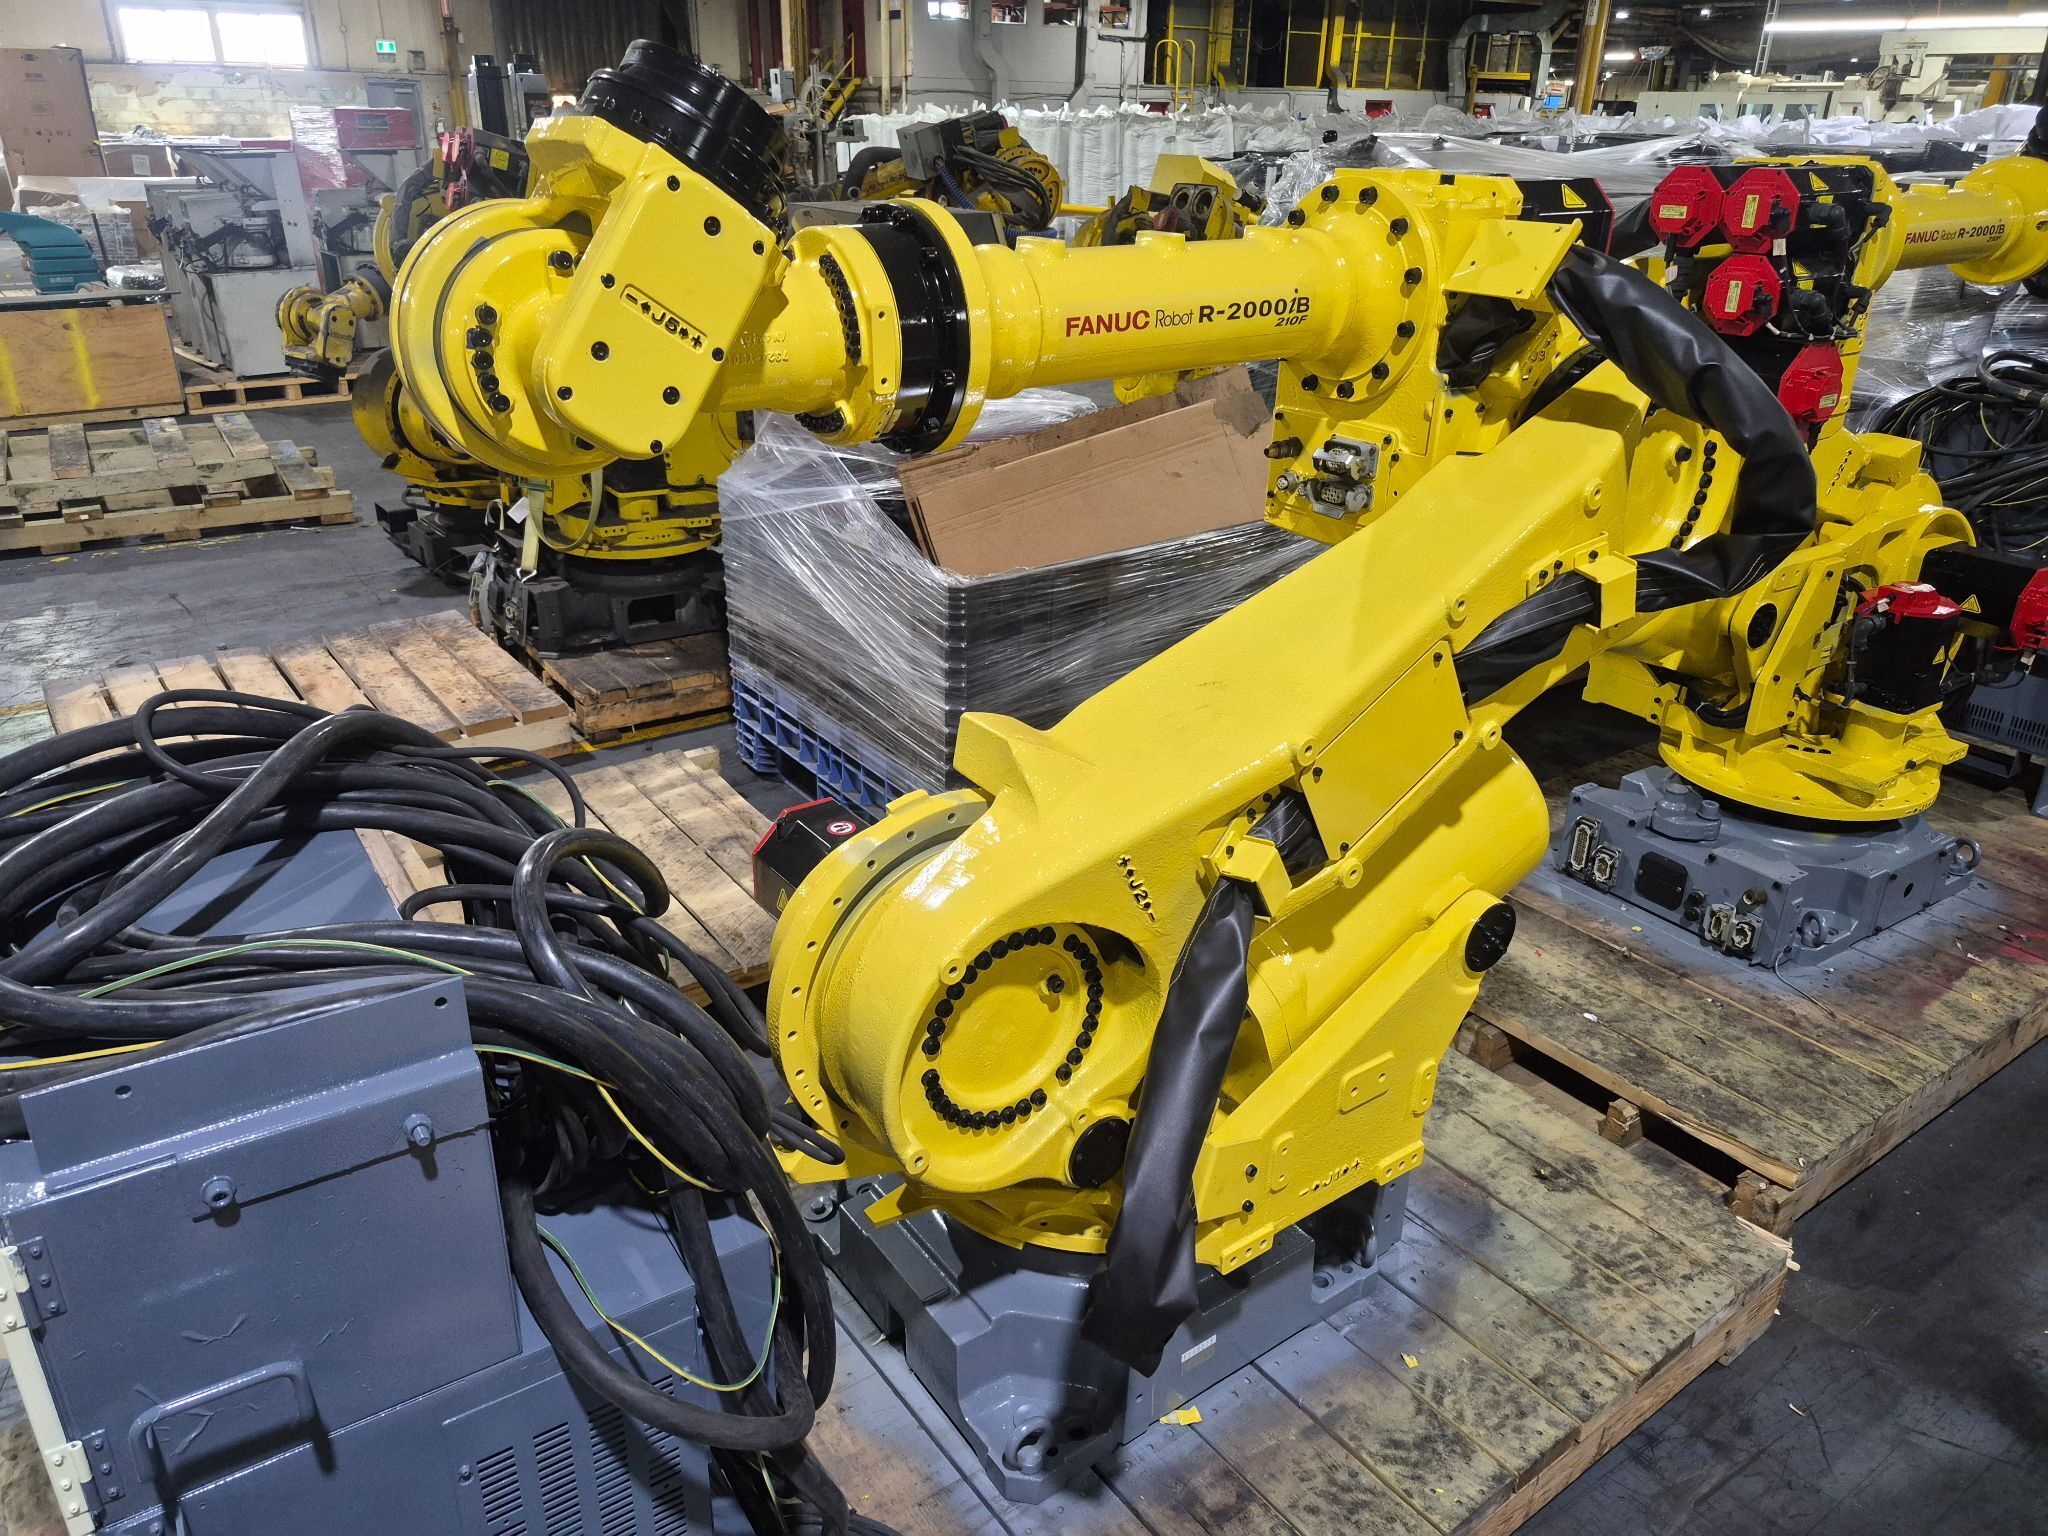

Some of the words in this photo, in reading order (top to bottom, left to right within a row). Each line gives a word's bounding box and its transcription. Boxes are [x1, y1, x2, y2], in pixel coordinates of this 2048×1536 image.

[1905, 230, 1940, 245] FANUC
[1940, 229, 1957, 241] Robot
[1065, 309, 1150, 337] FANUC
[1155, 308, 1194, 328] Robot
[1198, 288, 1310, 324] R-2000iB
[1274, 314, 1309, 327] 210F
